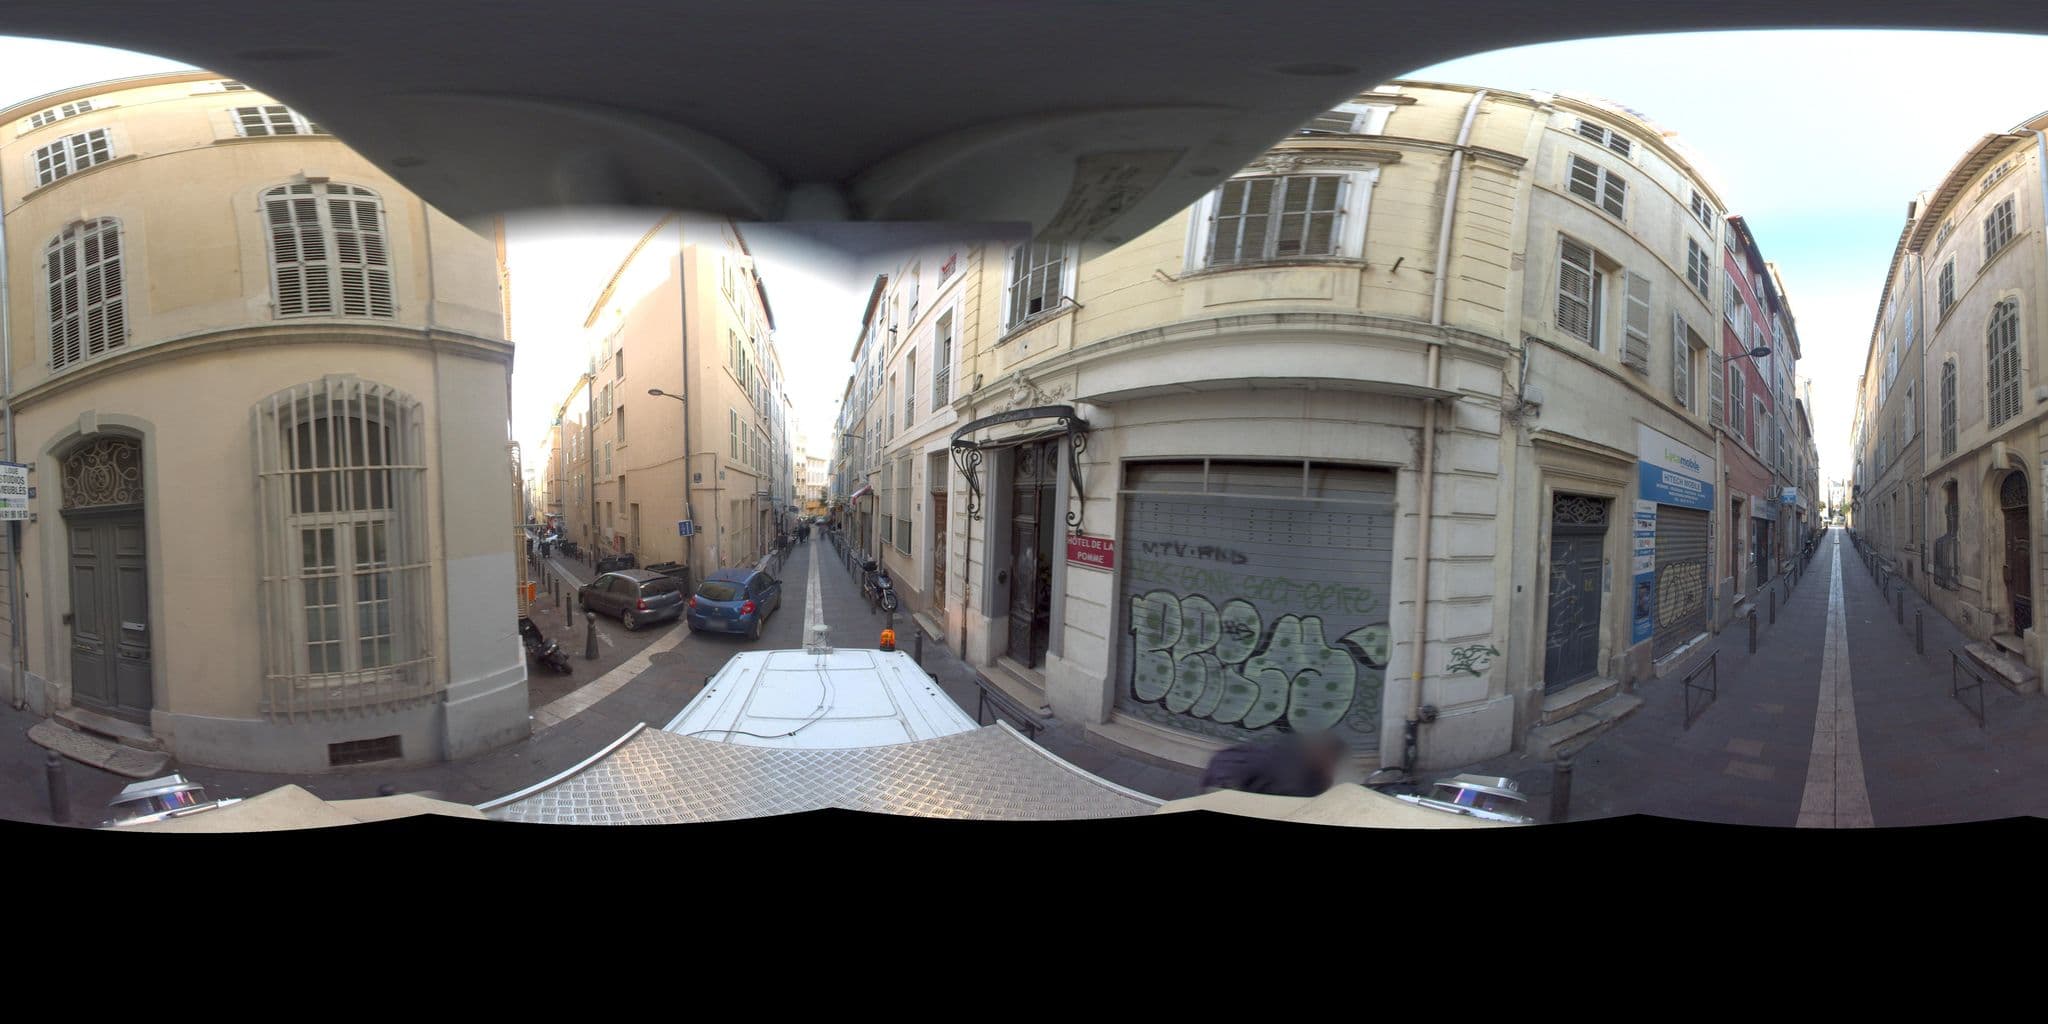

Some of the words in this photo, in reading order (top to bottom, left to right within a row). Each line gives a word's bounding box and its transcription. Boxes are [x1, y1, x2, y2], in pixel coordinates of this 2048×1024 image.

[1067, 536, 1090, 548] HÔTEL
[1091, 540, 1102, 550] DE
[1103, 542, 1114, 552] LA
[1077, 551, 1105, 564] POMME
